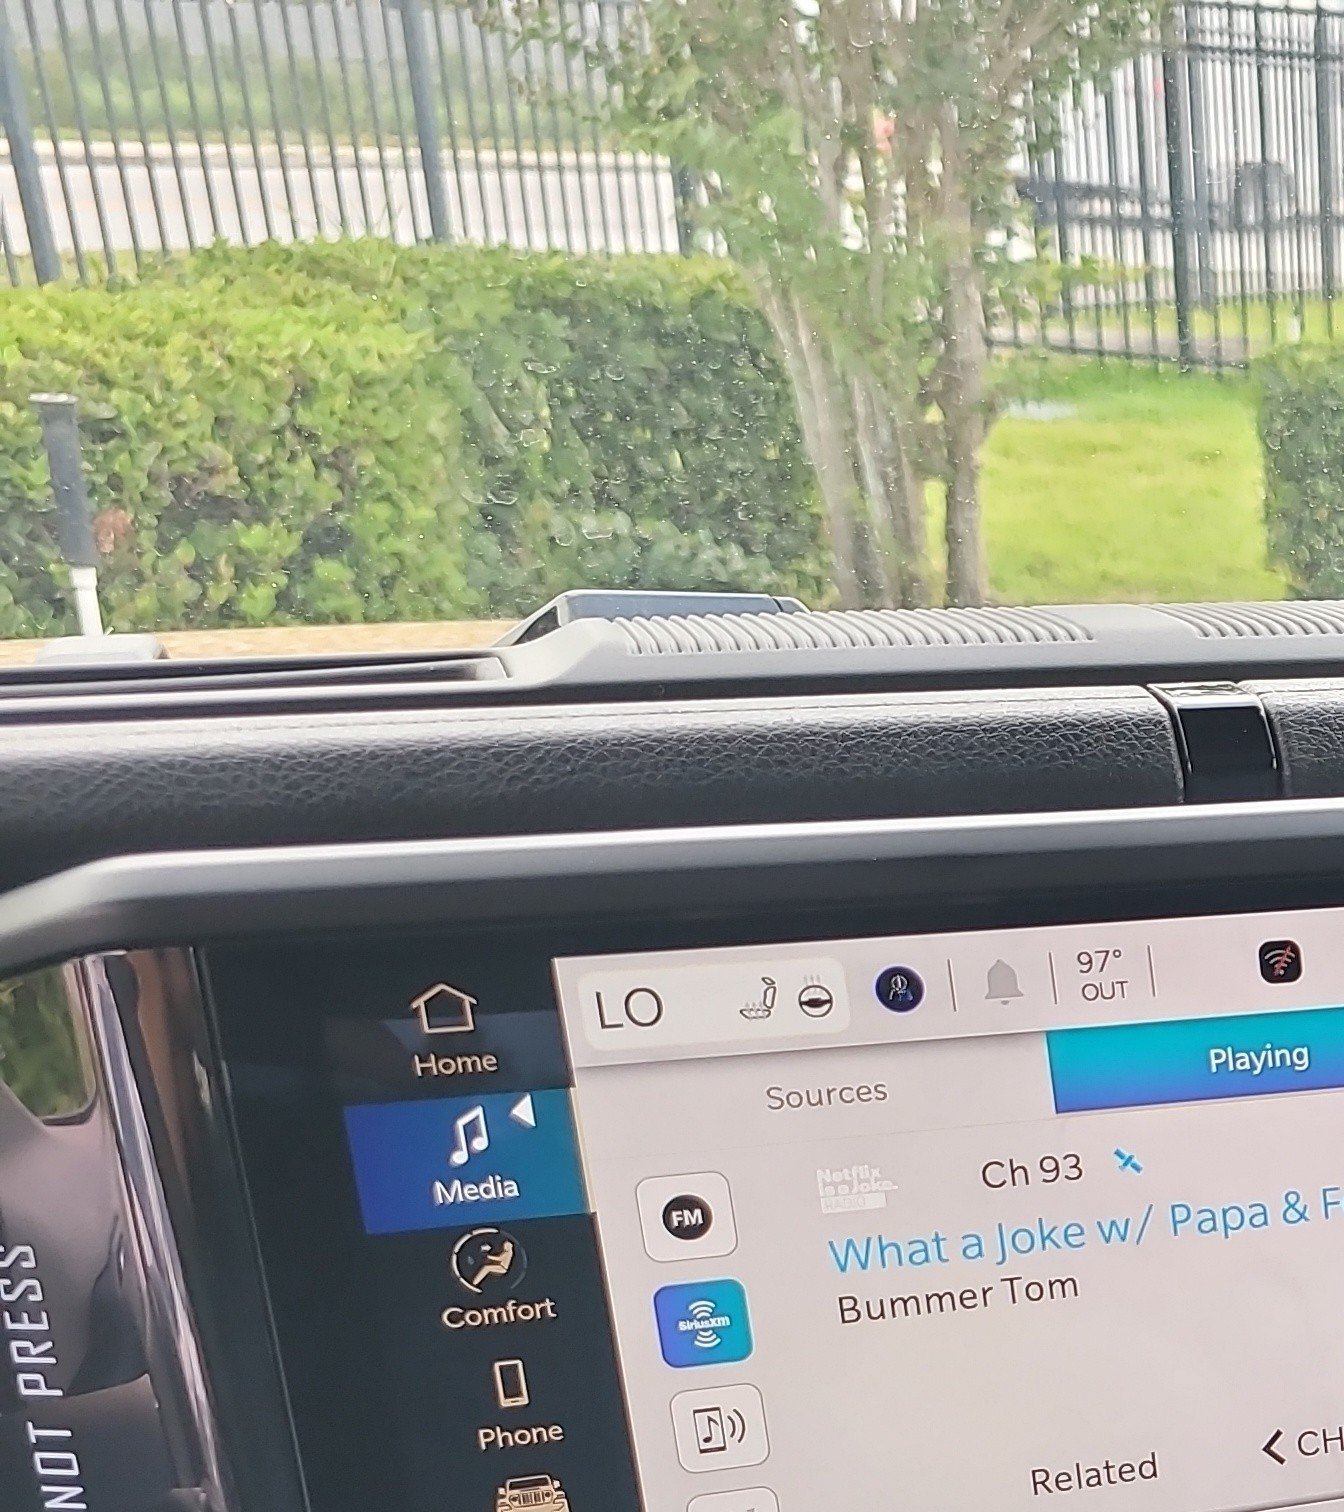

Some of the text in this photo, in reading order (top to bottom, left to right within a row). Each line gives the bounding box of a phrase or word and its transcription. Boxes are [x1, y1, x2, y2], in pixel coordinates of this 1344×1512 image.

[1077, 949, 1123, 975] 97°
[1081, 980, 1129, 1002] OUT
[597, 986, 664, 1031] LO
[414, 1050, 499, 1078] Home
[1209, 1043, 1311, 1074] Playing
[765, 1080, 888, 1111] Sources
[981, 1154, 1084, 1188] Ch 93
[433, 1176, 520, 1205] Media
[671, 1208, 704, 1228] FM
[828, 1230, 948, 1275] What
[960, 1230, 985, 1261] a
[997, 1215, 1087, 1265] Joke
[1096, 1204, 1154, 1247] w/
[1170, 1201, 1270, 1240] Papa
[1281, 1191, 1311, 1225] &
[442, 1297, 557, 1331] Comfort
[837, 1273, 1080, 1326] Bummer Tom
[0, 1245, 64, 1397] PRESS
[477, 1423, 566, 1451] Phone
[25, 1421, 88, 1510] NOT
[1030, 1452, 1159, 1497] Related
